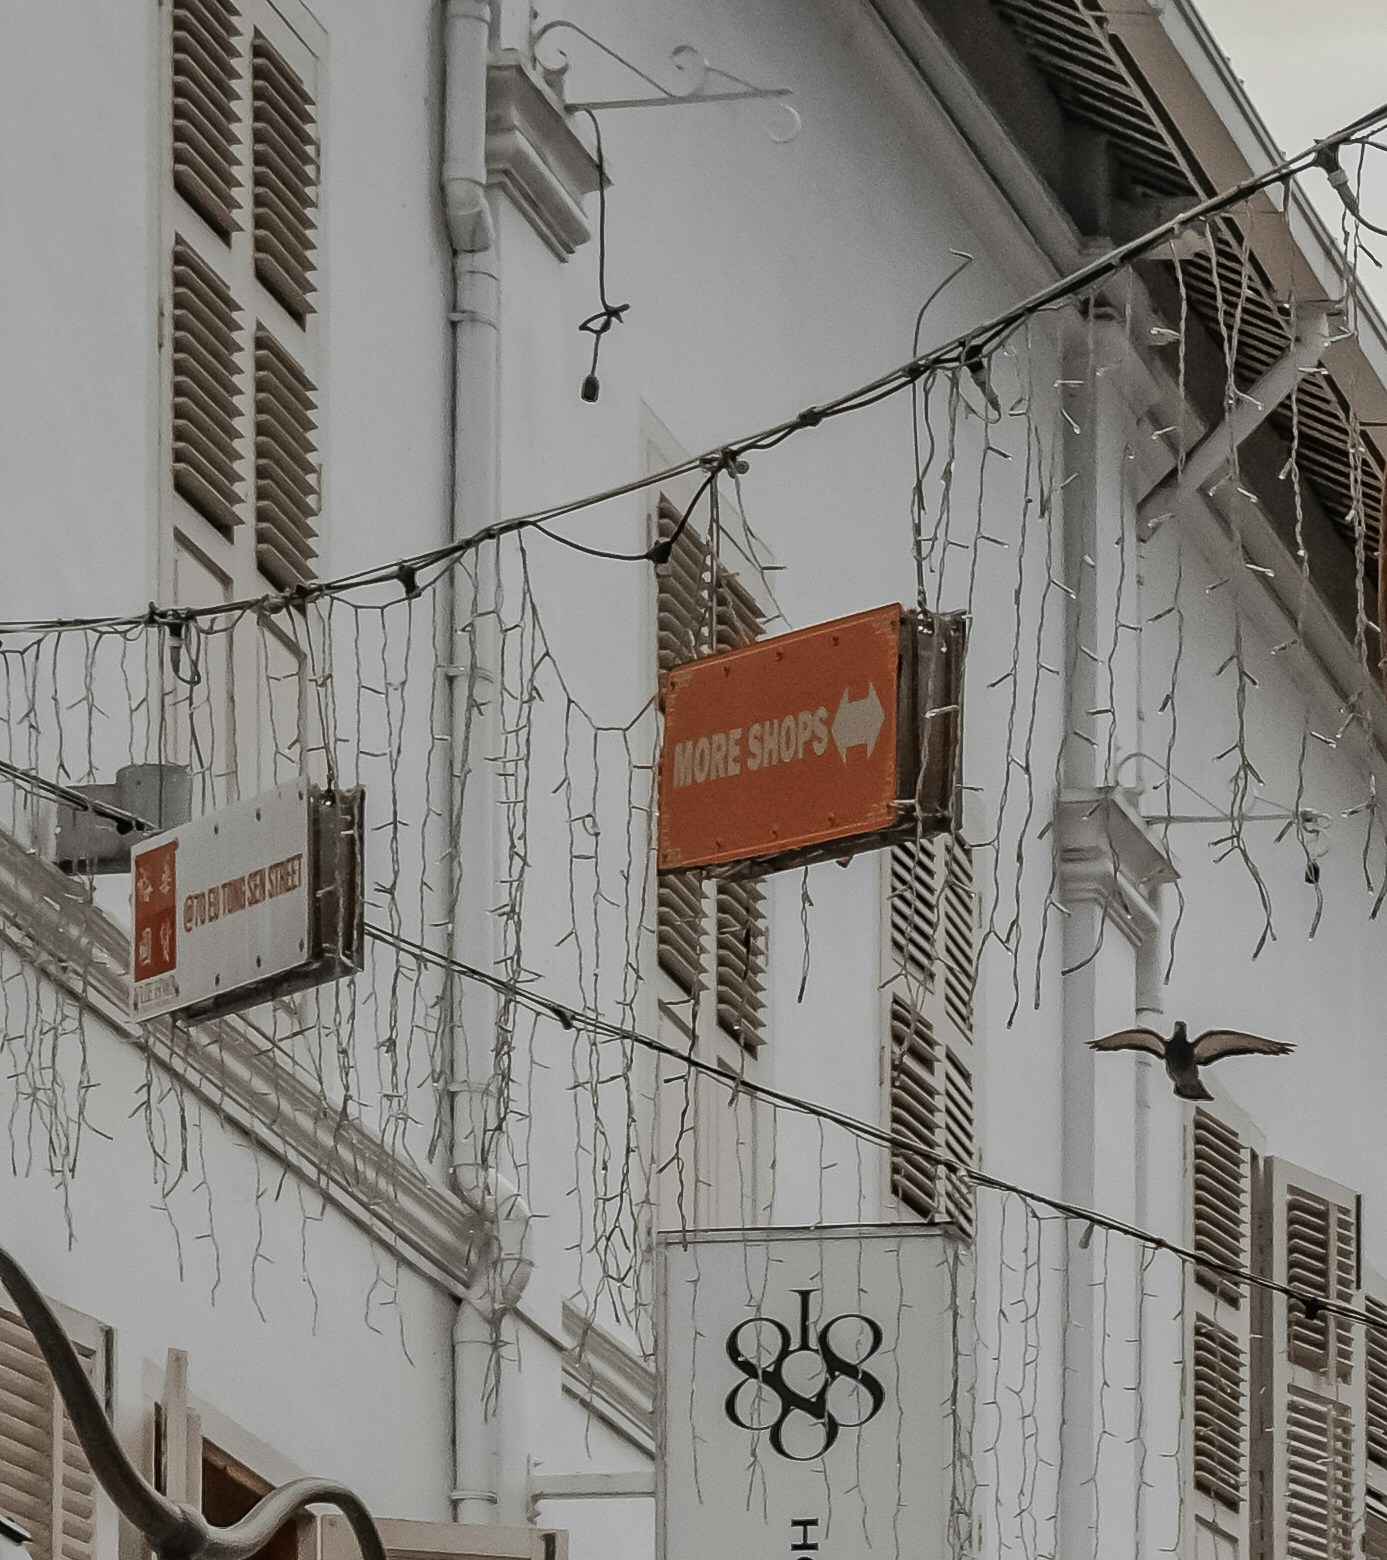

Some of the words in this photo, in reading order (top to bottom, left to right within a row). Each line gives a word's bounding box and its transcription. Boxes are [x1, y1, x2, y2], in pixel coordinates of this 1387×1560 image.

[671, 729, 741, 790] MORE
[746, 705, 830, 774] SHOPS
[220, 875, 247, 917] TONG
[247, 866, 267, 907] SEN
[268, 852, 303, 899] STREET
